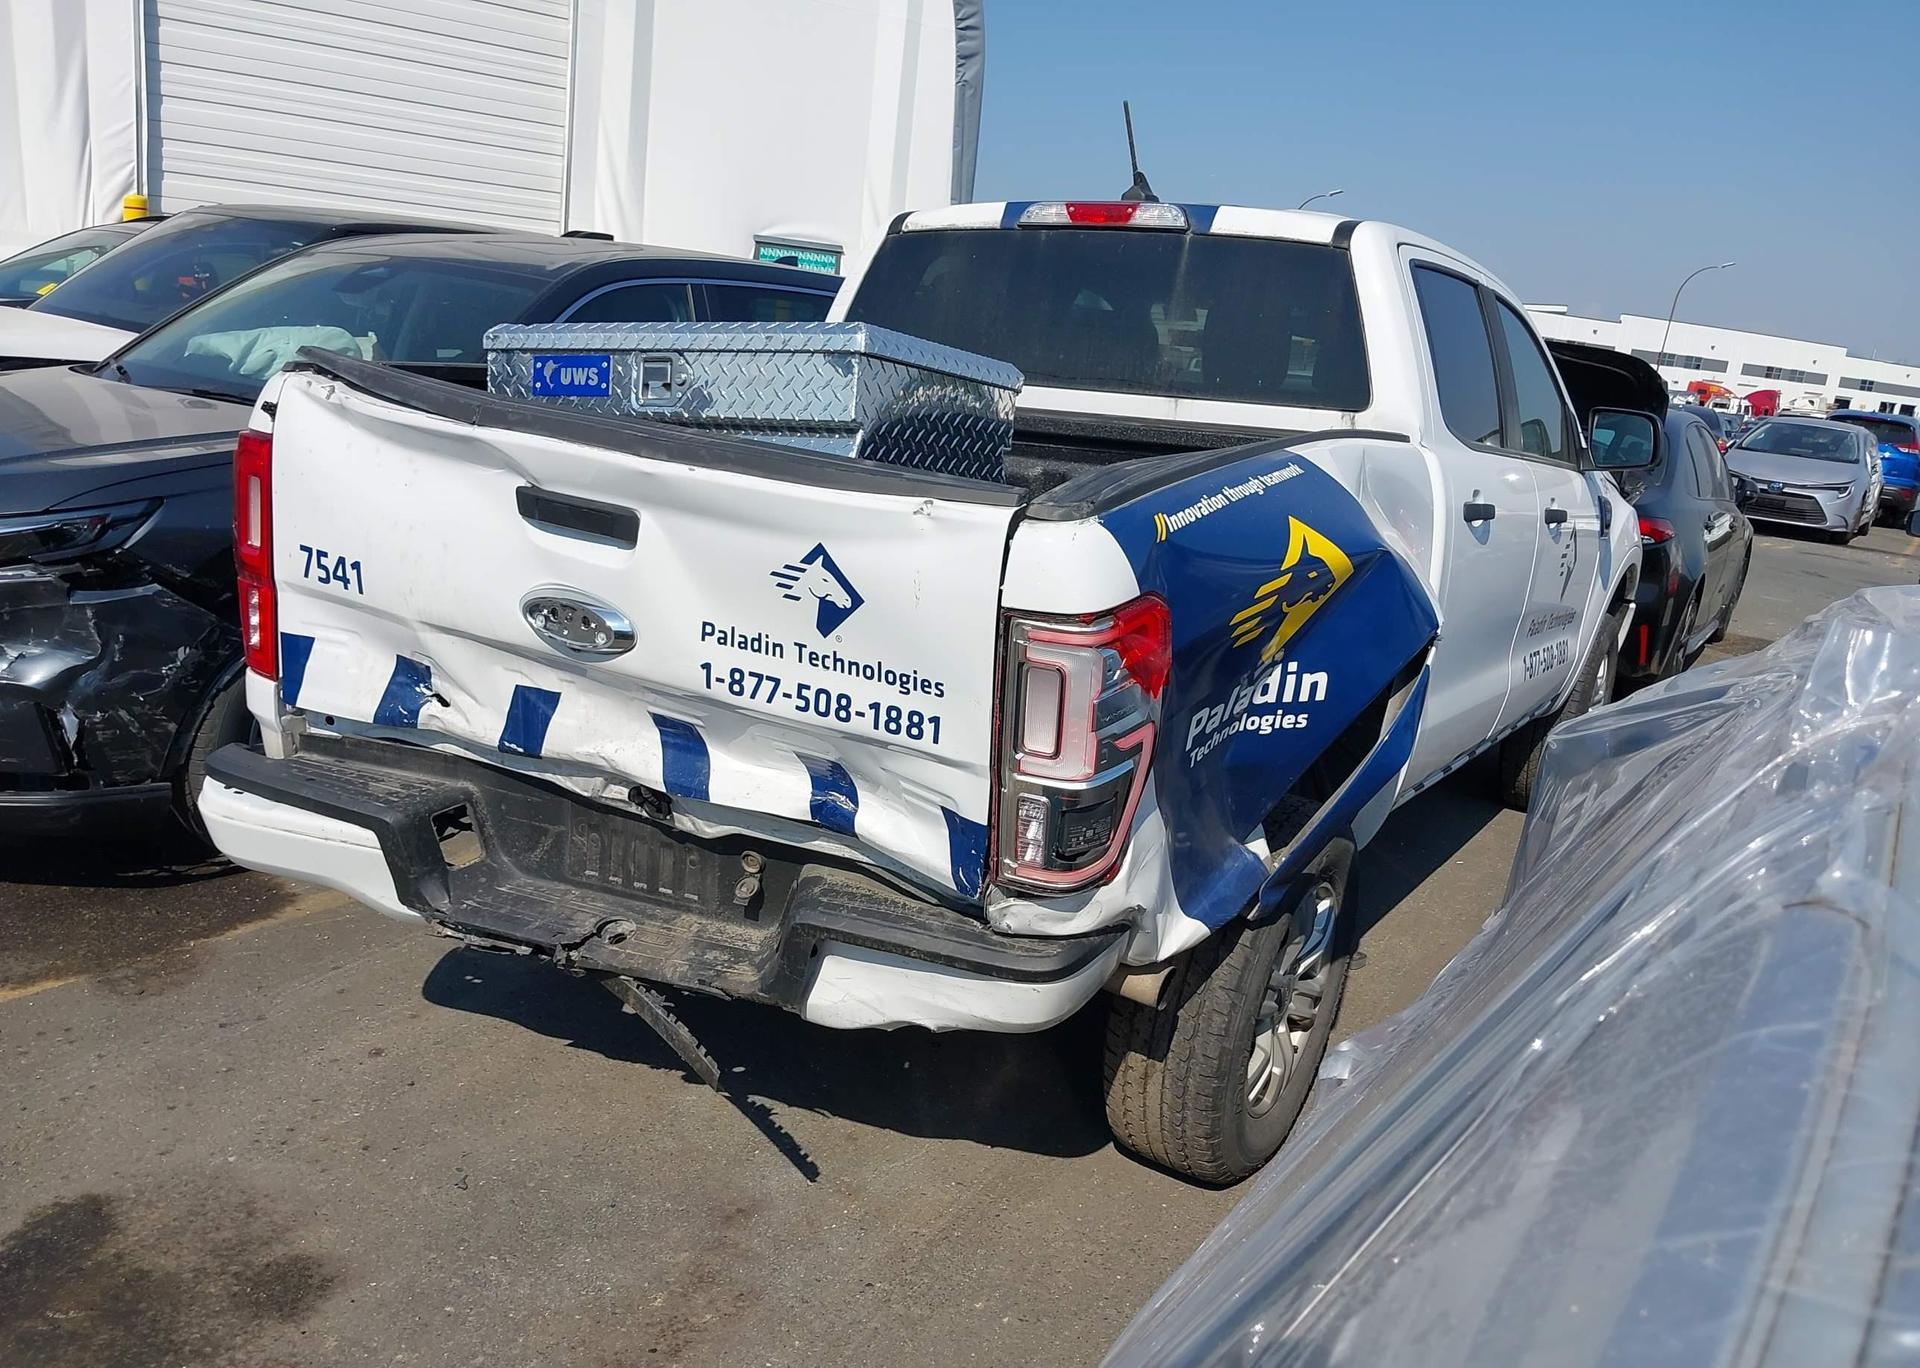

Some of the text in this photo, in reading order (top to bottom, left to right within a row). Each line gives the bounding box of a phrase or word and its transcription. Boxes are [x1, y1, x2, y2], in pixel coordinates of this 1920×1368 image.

[560, 367, 599, 386] UWS
[1163, 461, 1305, 533] Innovation through teamwork
[299, 543, 364, 596] 7541
[700, 620, 946, 698] Paladin Technologies
[699, 661, 942, 745] 1-877-508-1881
[1185, 661, 1329, 752] Paladin
[1189, 709, 1309, 769] Technologies
